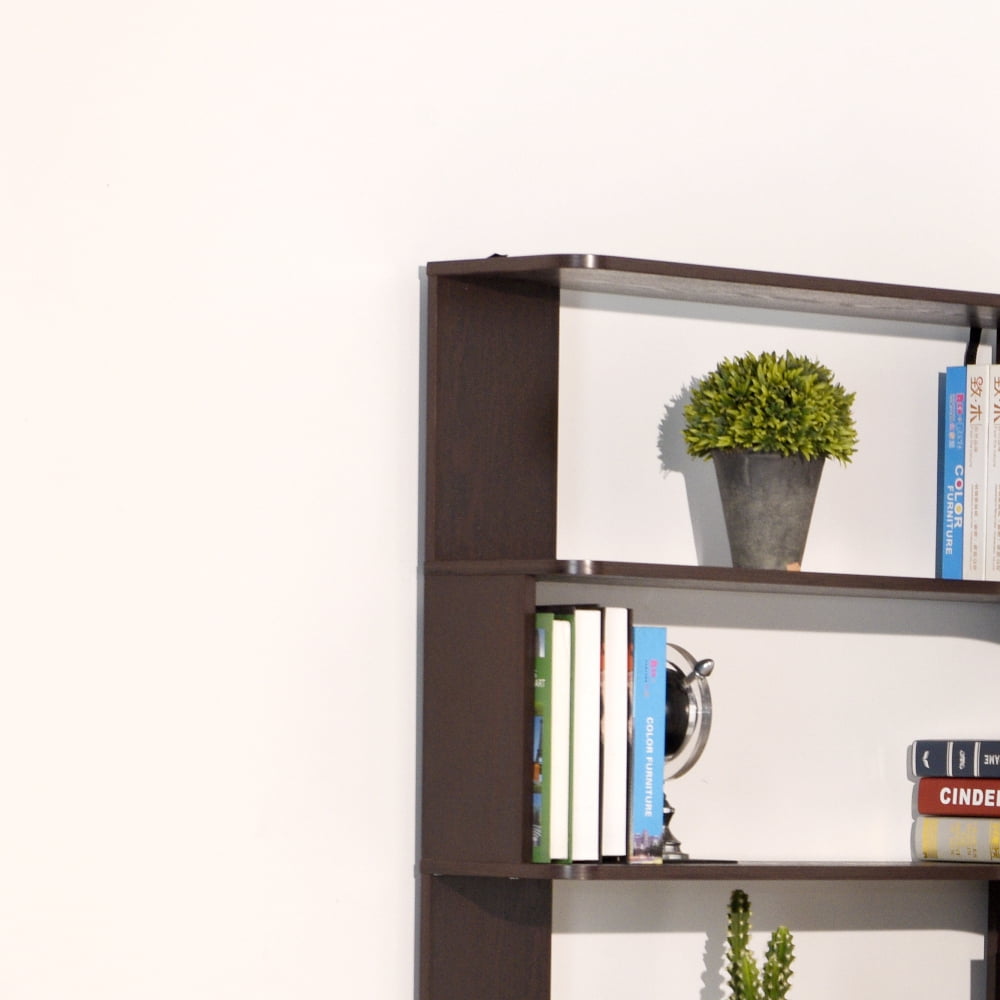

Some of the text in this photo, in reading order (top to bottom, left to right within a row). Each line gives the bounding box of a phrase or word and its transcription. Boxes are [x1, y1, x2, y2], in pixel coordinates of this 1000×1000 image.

[945, 485, 954, 555] FURNITURE
[954, 464, 964, 529] COLOR
[644, 716, 654, 817] COLOR FURNITURE
